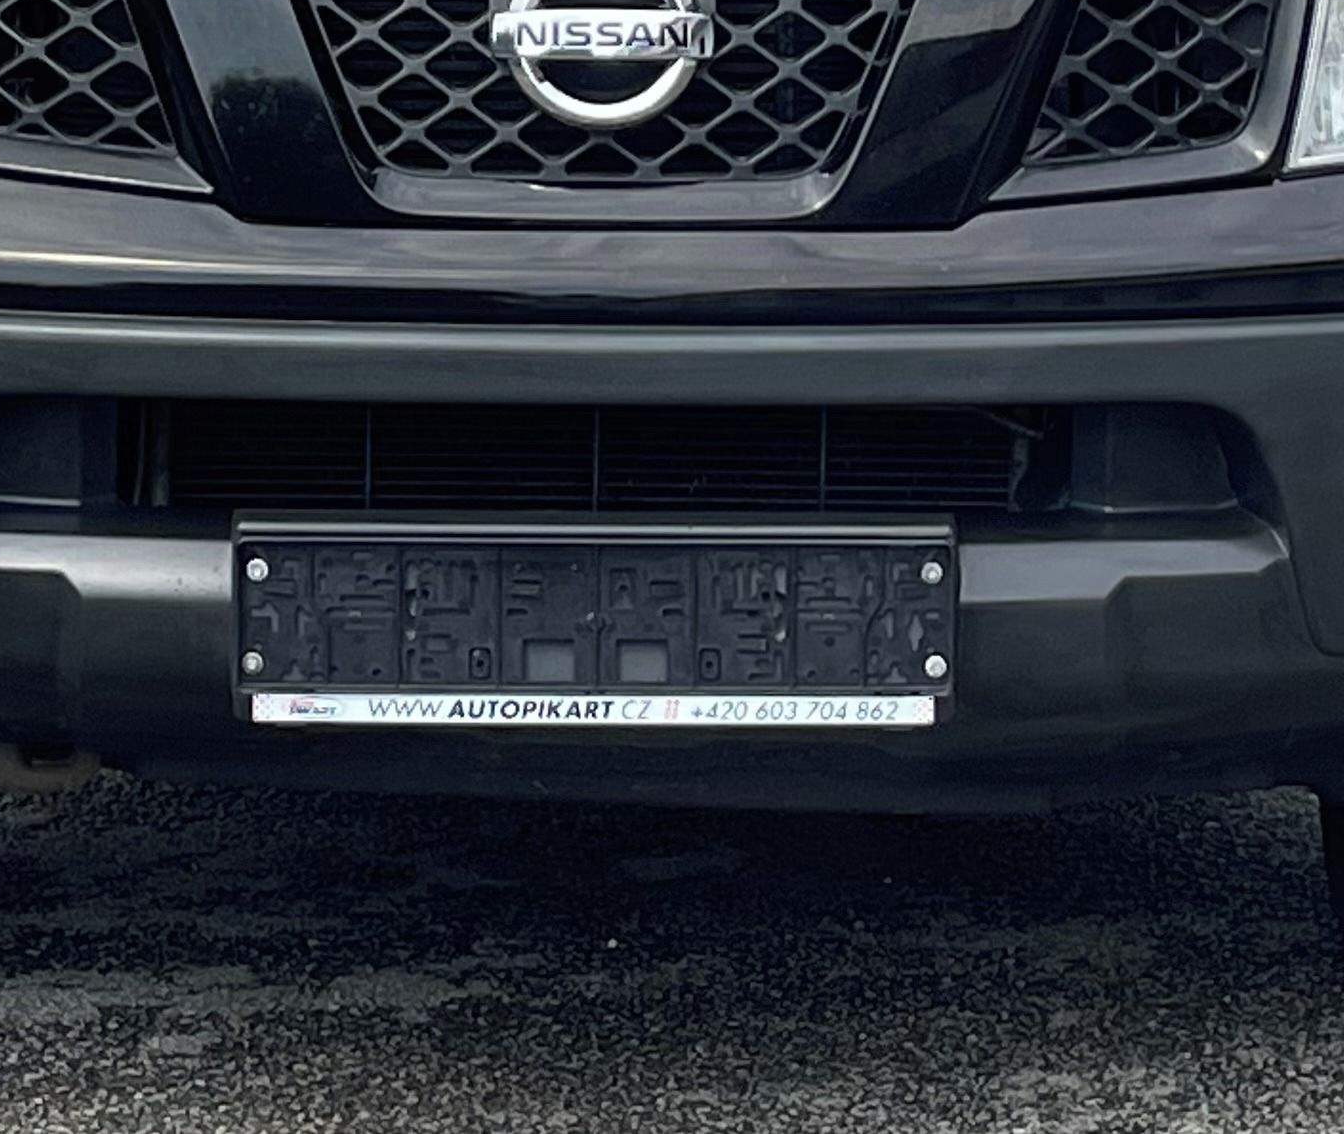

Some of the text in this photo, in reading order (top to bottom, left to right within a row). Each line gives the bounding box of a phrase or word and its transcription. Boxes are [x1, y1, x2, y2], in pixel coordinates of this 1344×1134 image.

[516, 22, 688, 48] NISSAN
[690, 701, 749, 721] +420
[755, 701, 799, 721] 603
[805, 701, 848, 721] 704
[855, 700, 900, 720] 862
